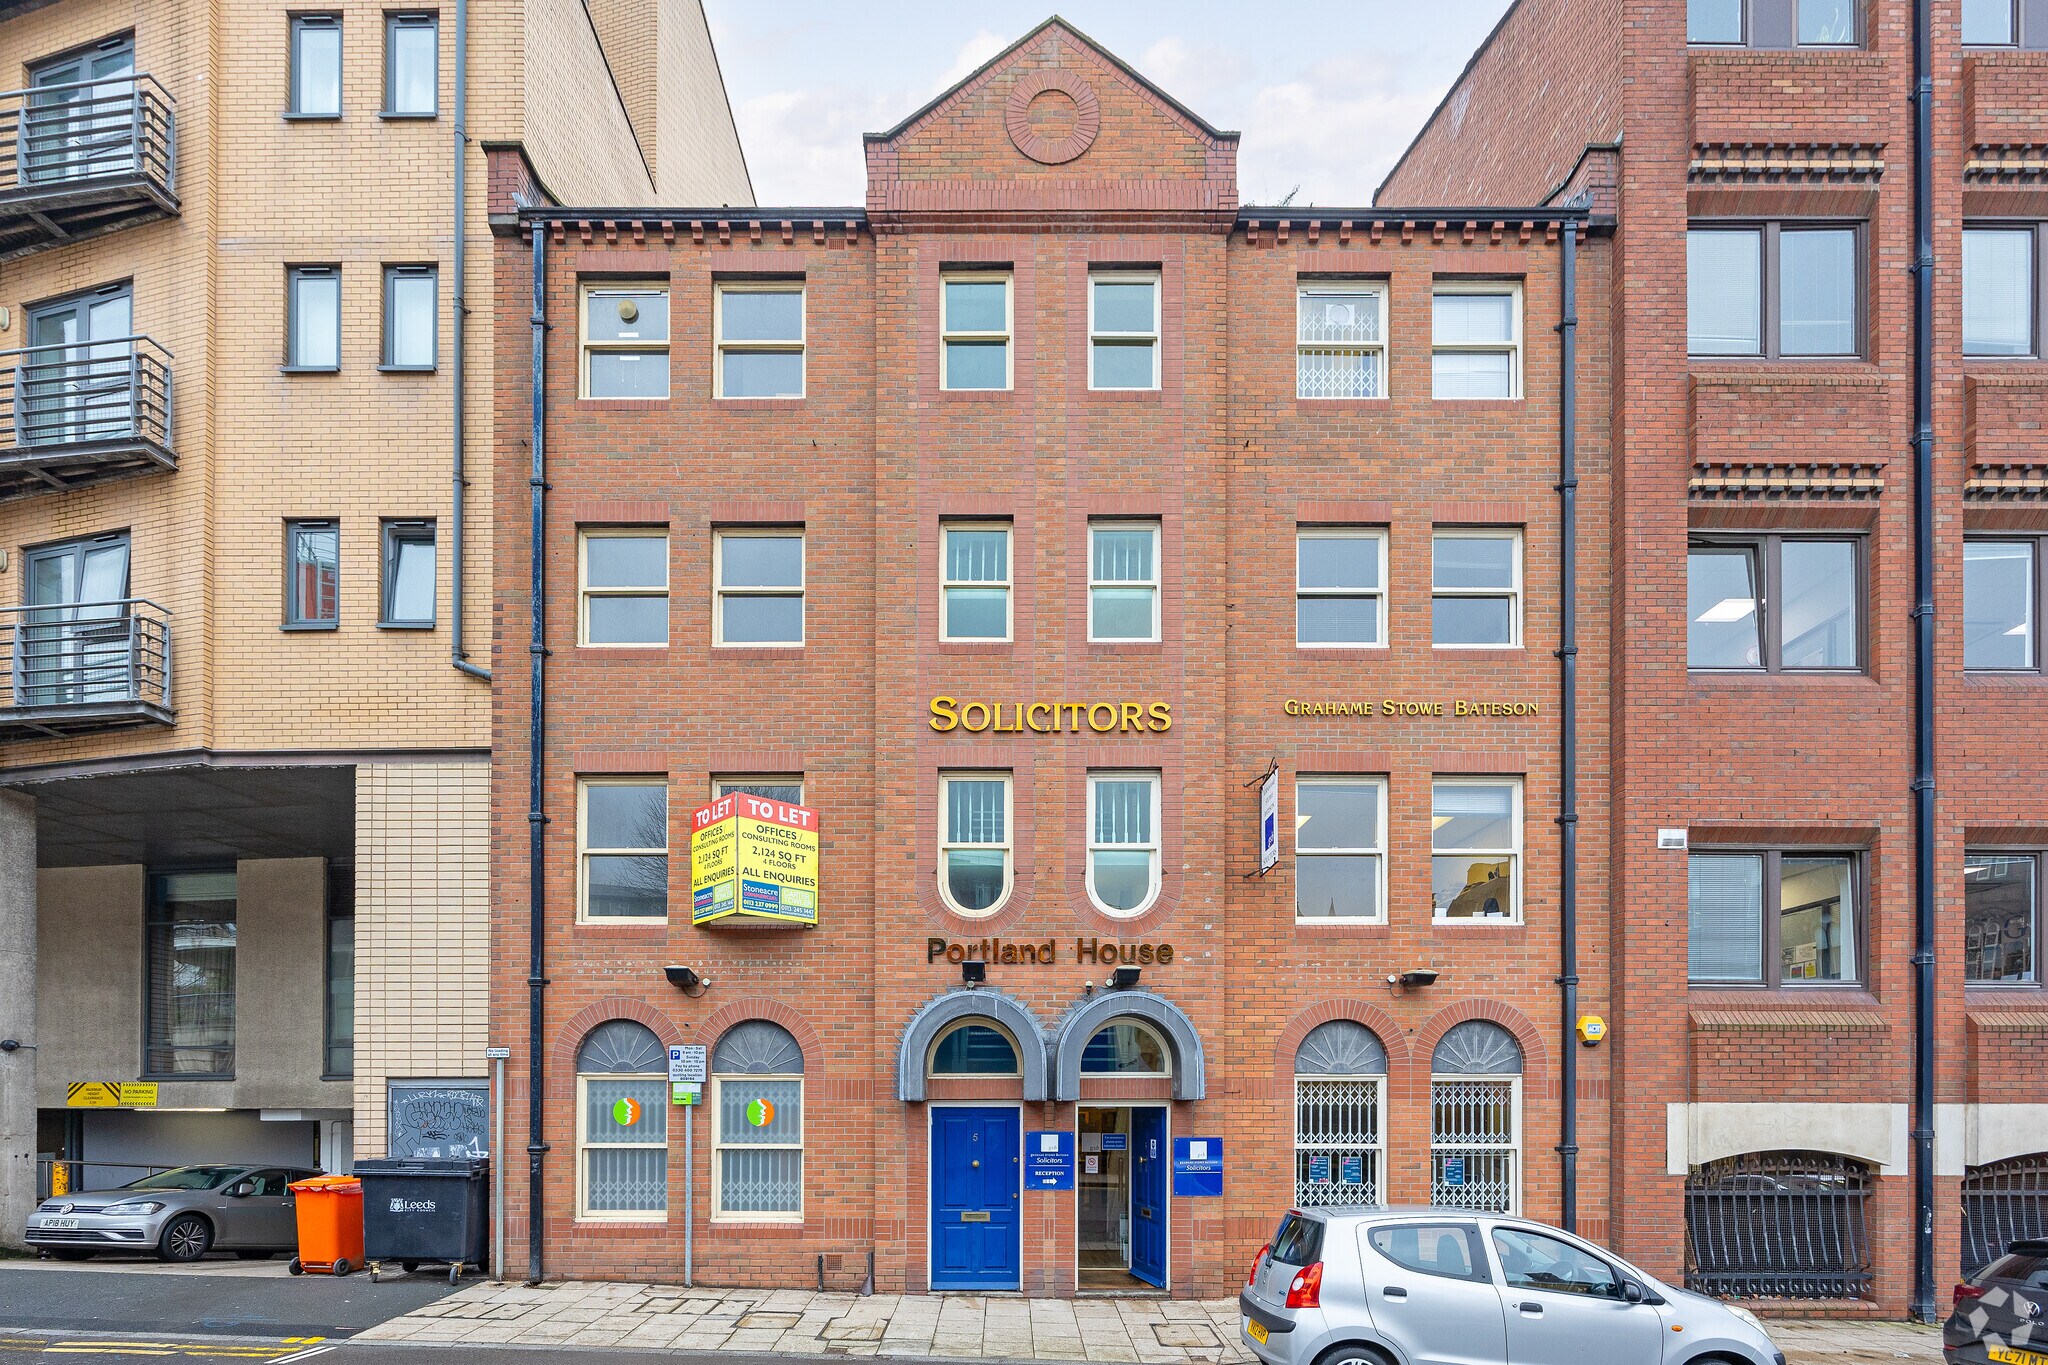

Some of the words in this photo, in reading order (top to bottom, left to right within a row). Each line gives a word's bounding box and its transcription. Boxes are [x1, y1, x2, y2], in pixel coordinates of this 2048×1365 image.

[928, 696, 1173, 732] SOLICITORS
[1284, 699, 1374, 716] GRAHAME
[1382, 699, 1444, 716] STOWE
[1455, 700, 1540, 716] BATESON
[696, 808, 710, 827] TO
[712, 798, 732, 820] LET
[748, 798, 773, 818] TO
[779, 806, 810, 826] LET
[700, 825, 723, 841] OFFICES
[756, 824, 797, 840] OFFICES
[742, 832, 788, 847] CONSULTING
[791, 842, 815, 852] ROOMS
[712, 849, 720, 860] SQ
[721, 845, 729, 855] FT
[752, 846, 775, 858] 2,124
[778, 851, 792, 862] SQ
[795, 854, 806, 863] FT
[769, 860, 796, 870] FLOORS
[694, 877, 703, 888] ALL
[704, 866, 734, 884] ENQUIRIES
[742, 867, 760, 877] ALL
[764, 870, 815, 887] ENQUIRIES
[744, 884, 778, 896] Stoneacre
[927, 937, 1056, 964] Portland
[1077, 937, 1174, 964] House
[673, 1051, 679, 1059] P
[973, 1133, 978, 1142] 5
[405, 1200, 436, 1209] Leeds
[2020, 1318, 2044, 1326] POLO
[1998, 1347, 2026, 1364] YC71
